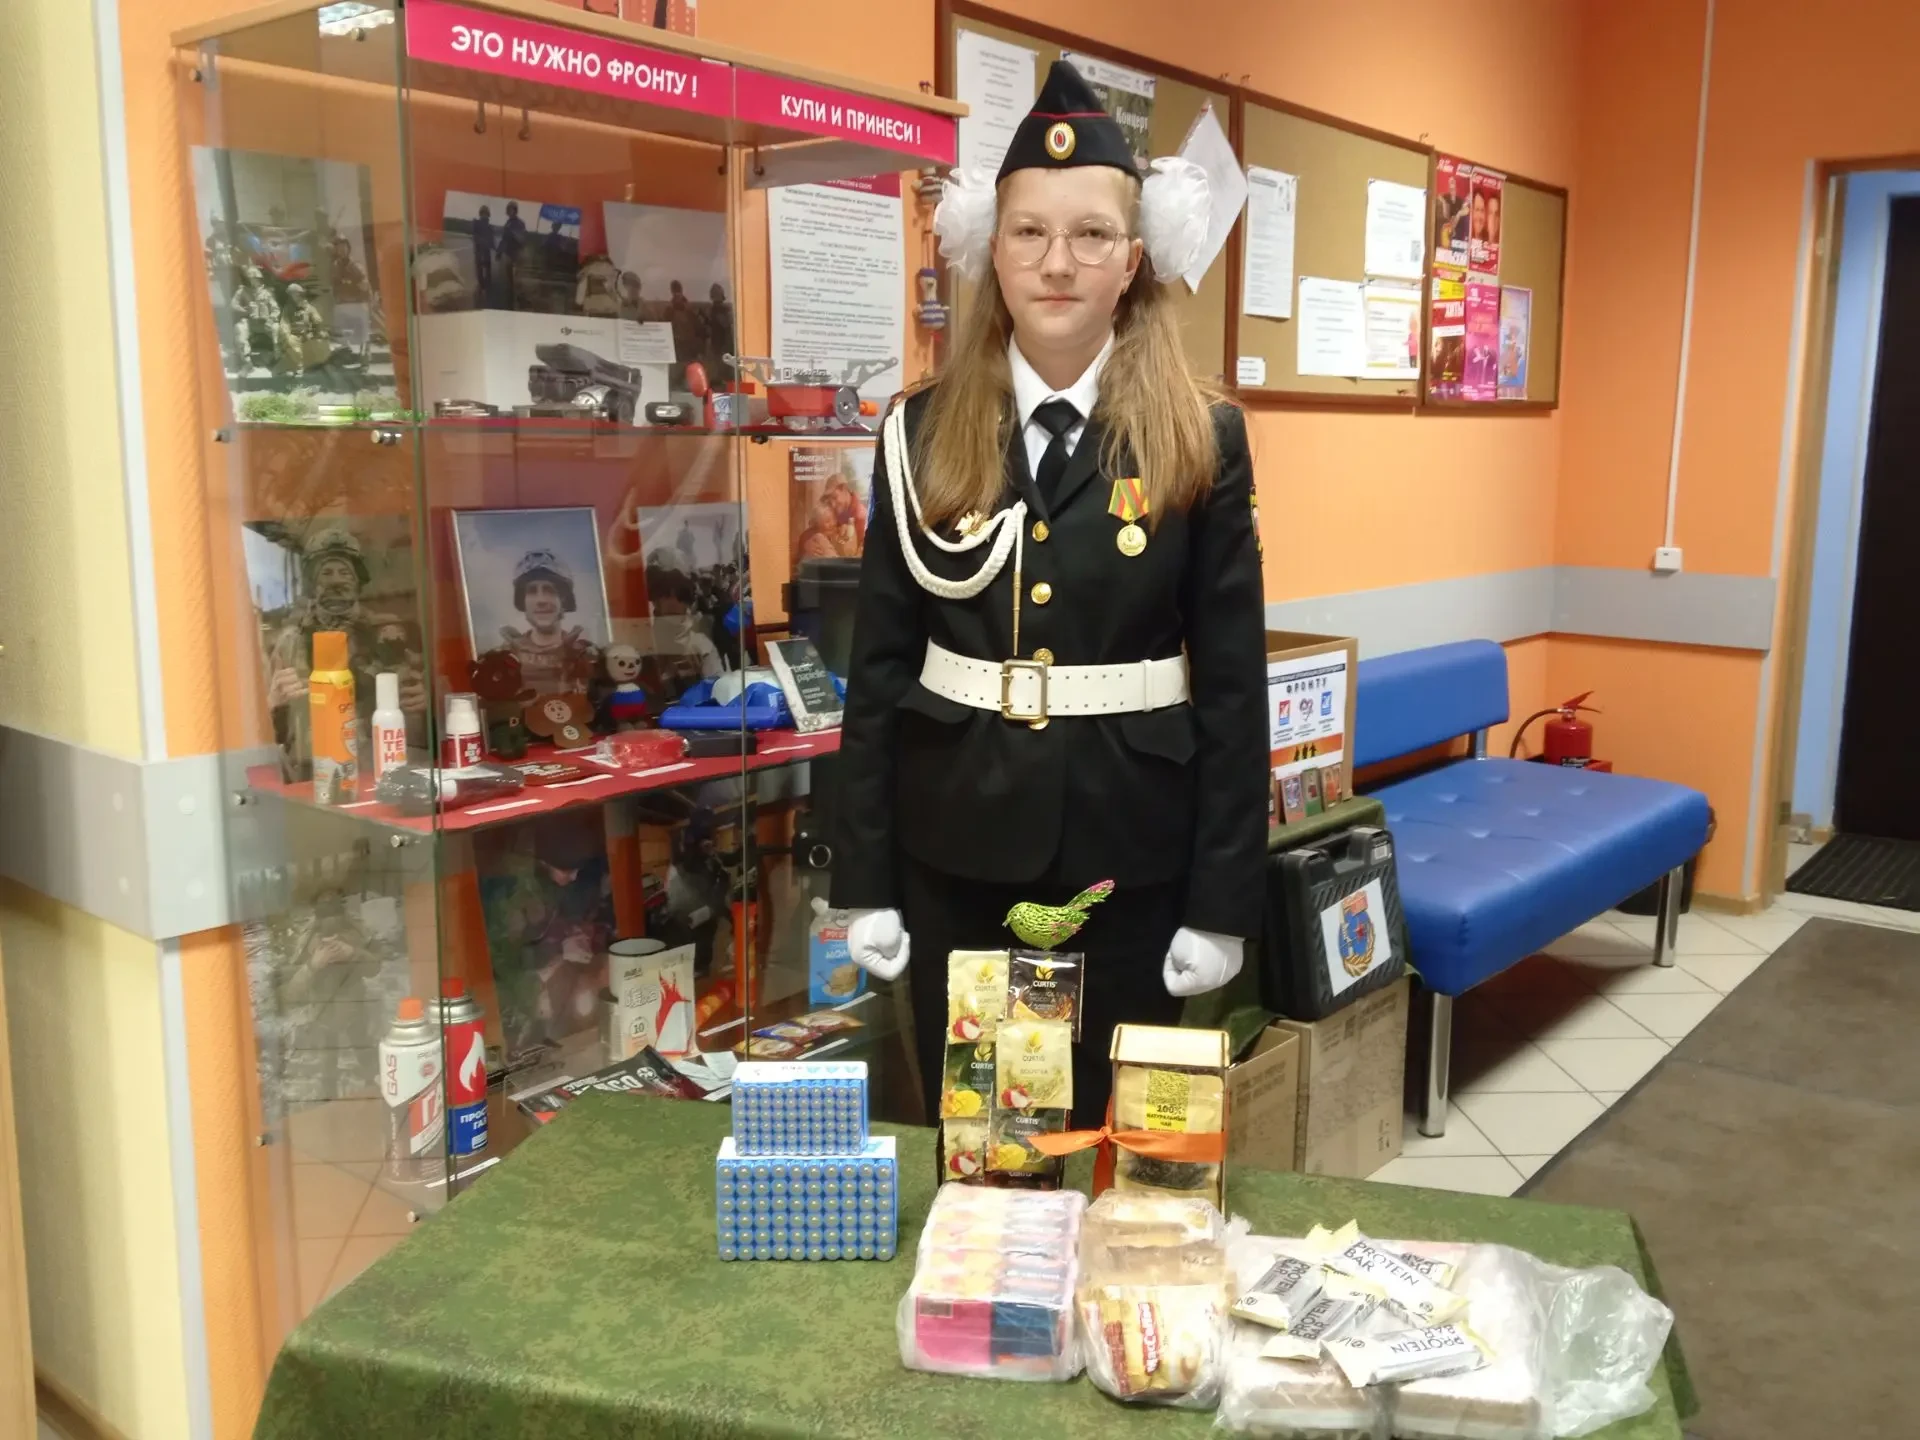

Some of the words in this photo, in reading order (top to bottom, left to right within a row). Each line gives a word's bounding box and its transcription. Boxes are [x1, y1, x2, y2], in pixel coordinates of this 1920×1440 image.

[451, 25, 504, 58] ЭТО
[511, 37, 601, 78] НУЖНО
[606, 57, 687, 95] ФРОНТУ
[780, 94, 826, 123] КУПИ
[831, 104, 842, 127] И
[846, 108, 913, 143] ПРИНЕСИ
[1116, 106, 1148, 134] Концерт
[1286, 677, 1327, 694] ФРОНТУ
[1033, 980, 1057, 988] CURTIS
[386, 1054, 398, 1097] GAS
[970, 1062, 995, 1070] CURTIS
[1015, 1116, 1040, 1125] CURTIS
[1157, 1104, 1184, 1115] 100%
[1343, 1247, 1375, 1272] BAR
[1352, 1240, 1419, 1285] PROTEIN
[1273, 1262, 1311, 1297] PROTEIN
[1288, 1298, 1335, 1337] PROTEIN
[1303, 1321, 1330, 1340] BAR
[1390, 1335, 1465, 1354] PROTEIN
